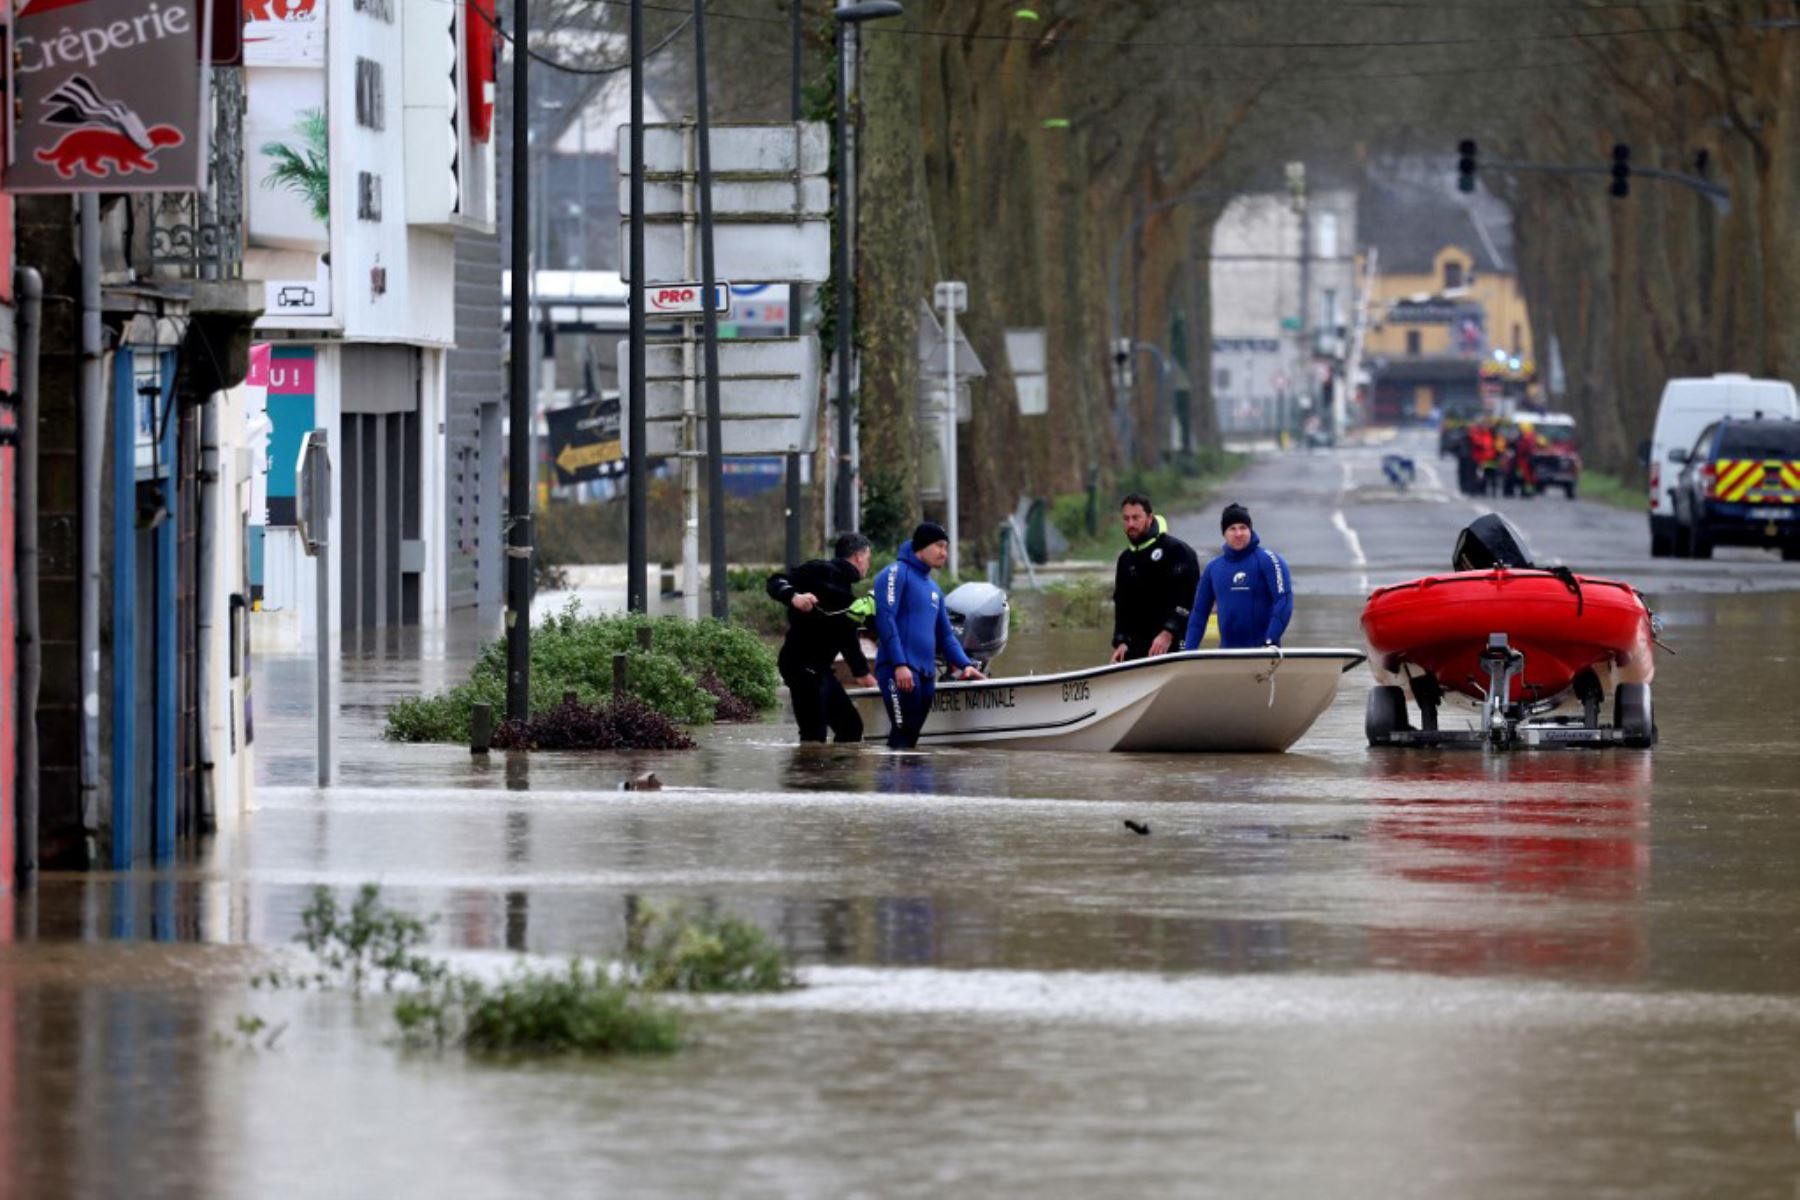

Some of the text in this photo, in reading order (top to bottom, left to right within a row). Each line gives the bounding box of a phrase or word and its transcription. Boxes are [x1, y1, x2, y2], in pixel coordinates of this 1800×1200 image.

[16, 2, 191, 73] Crêperie
[658, 289, 694, 303] PRO
[964, 688, 1016, 712] NATIONALE
[1061, 680, 1090, 703] G1205
